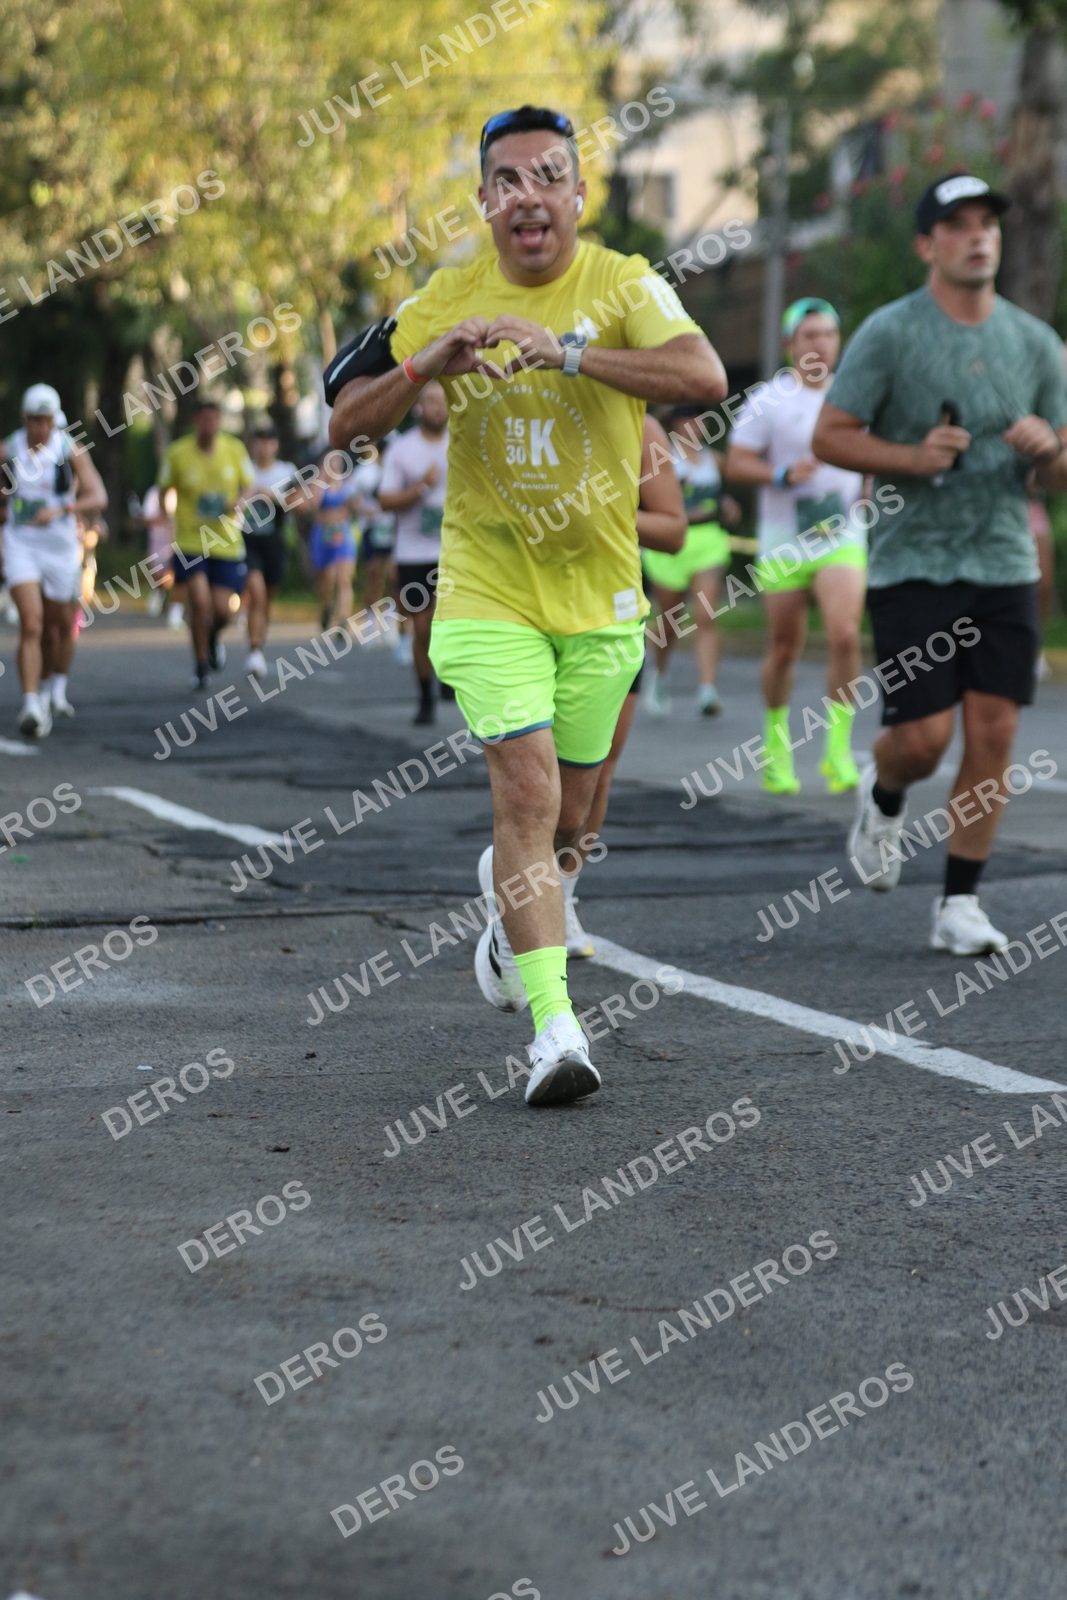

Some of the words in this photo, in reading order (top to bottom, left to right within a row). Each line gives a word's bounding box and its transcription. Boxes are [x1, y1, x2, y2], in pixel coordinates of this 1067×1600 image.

[504, 416, 525, 438] 15
[529, 418, 560, 467] K
[505, 445, 527, 465] 30
